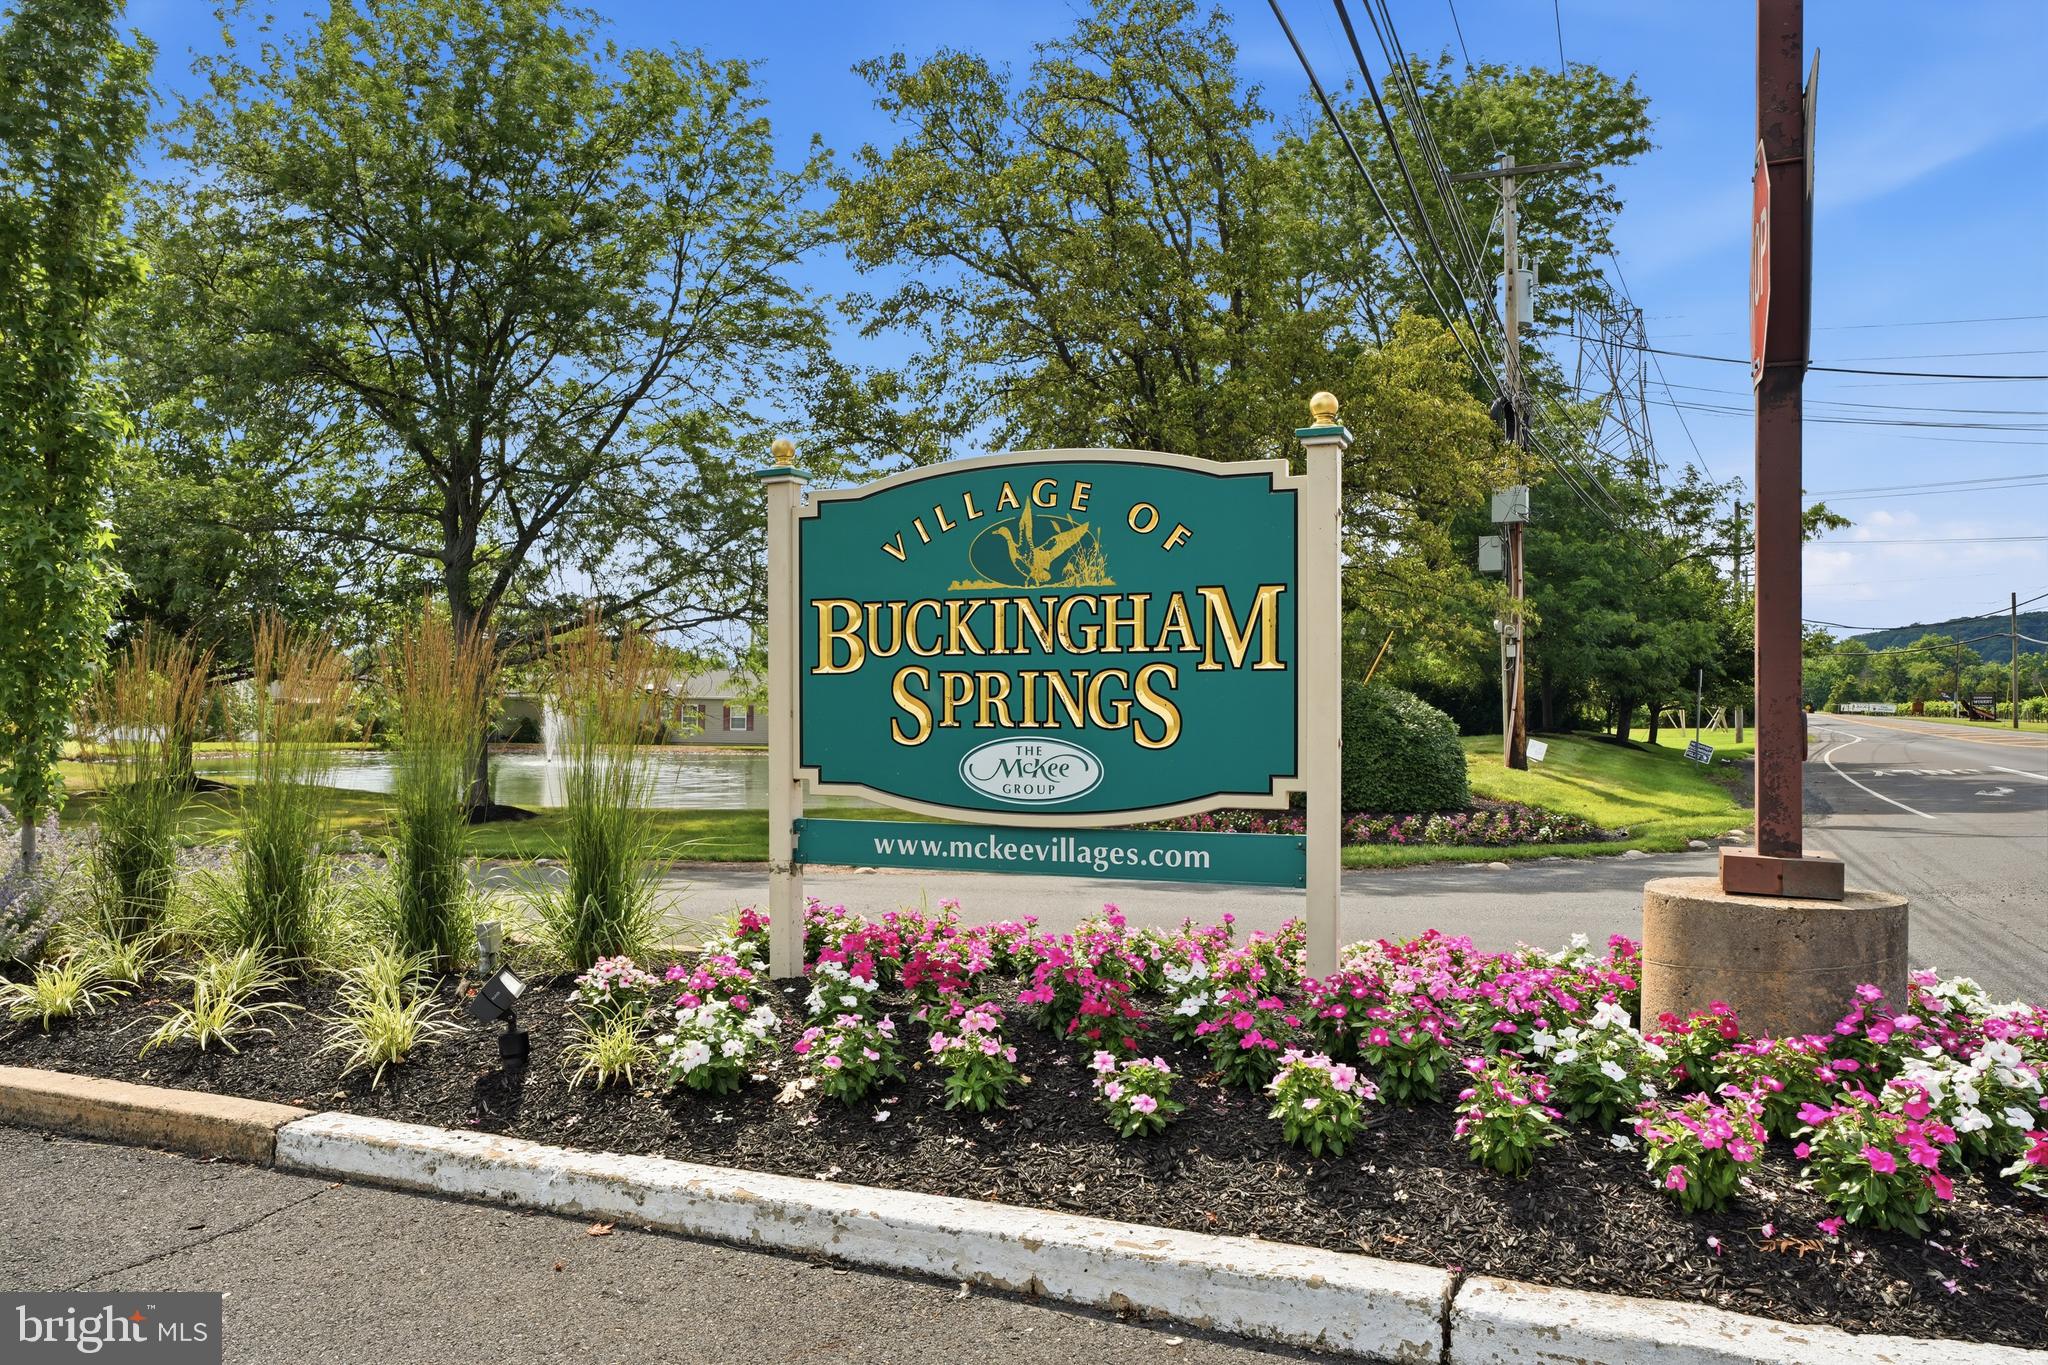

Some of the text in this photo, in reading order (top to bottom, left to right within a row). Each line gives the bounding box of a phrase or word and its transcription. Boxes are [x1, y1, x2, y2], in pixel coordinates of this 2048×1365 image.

[882, 478, 1193, 564] VILLAGE OF
[811, 583, 1287, 675] BUCKINGHAM
[890, 662, 1183, 750] SPRINGS
[969, 754, 1089, 783] McKee
[1016, 745, 1042, 756] THE
[1002, 783, 1055, 795] GROUP
[873, 834, 1211, 871] www.mckeevillages.com
